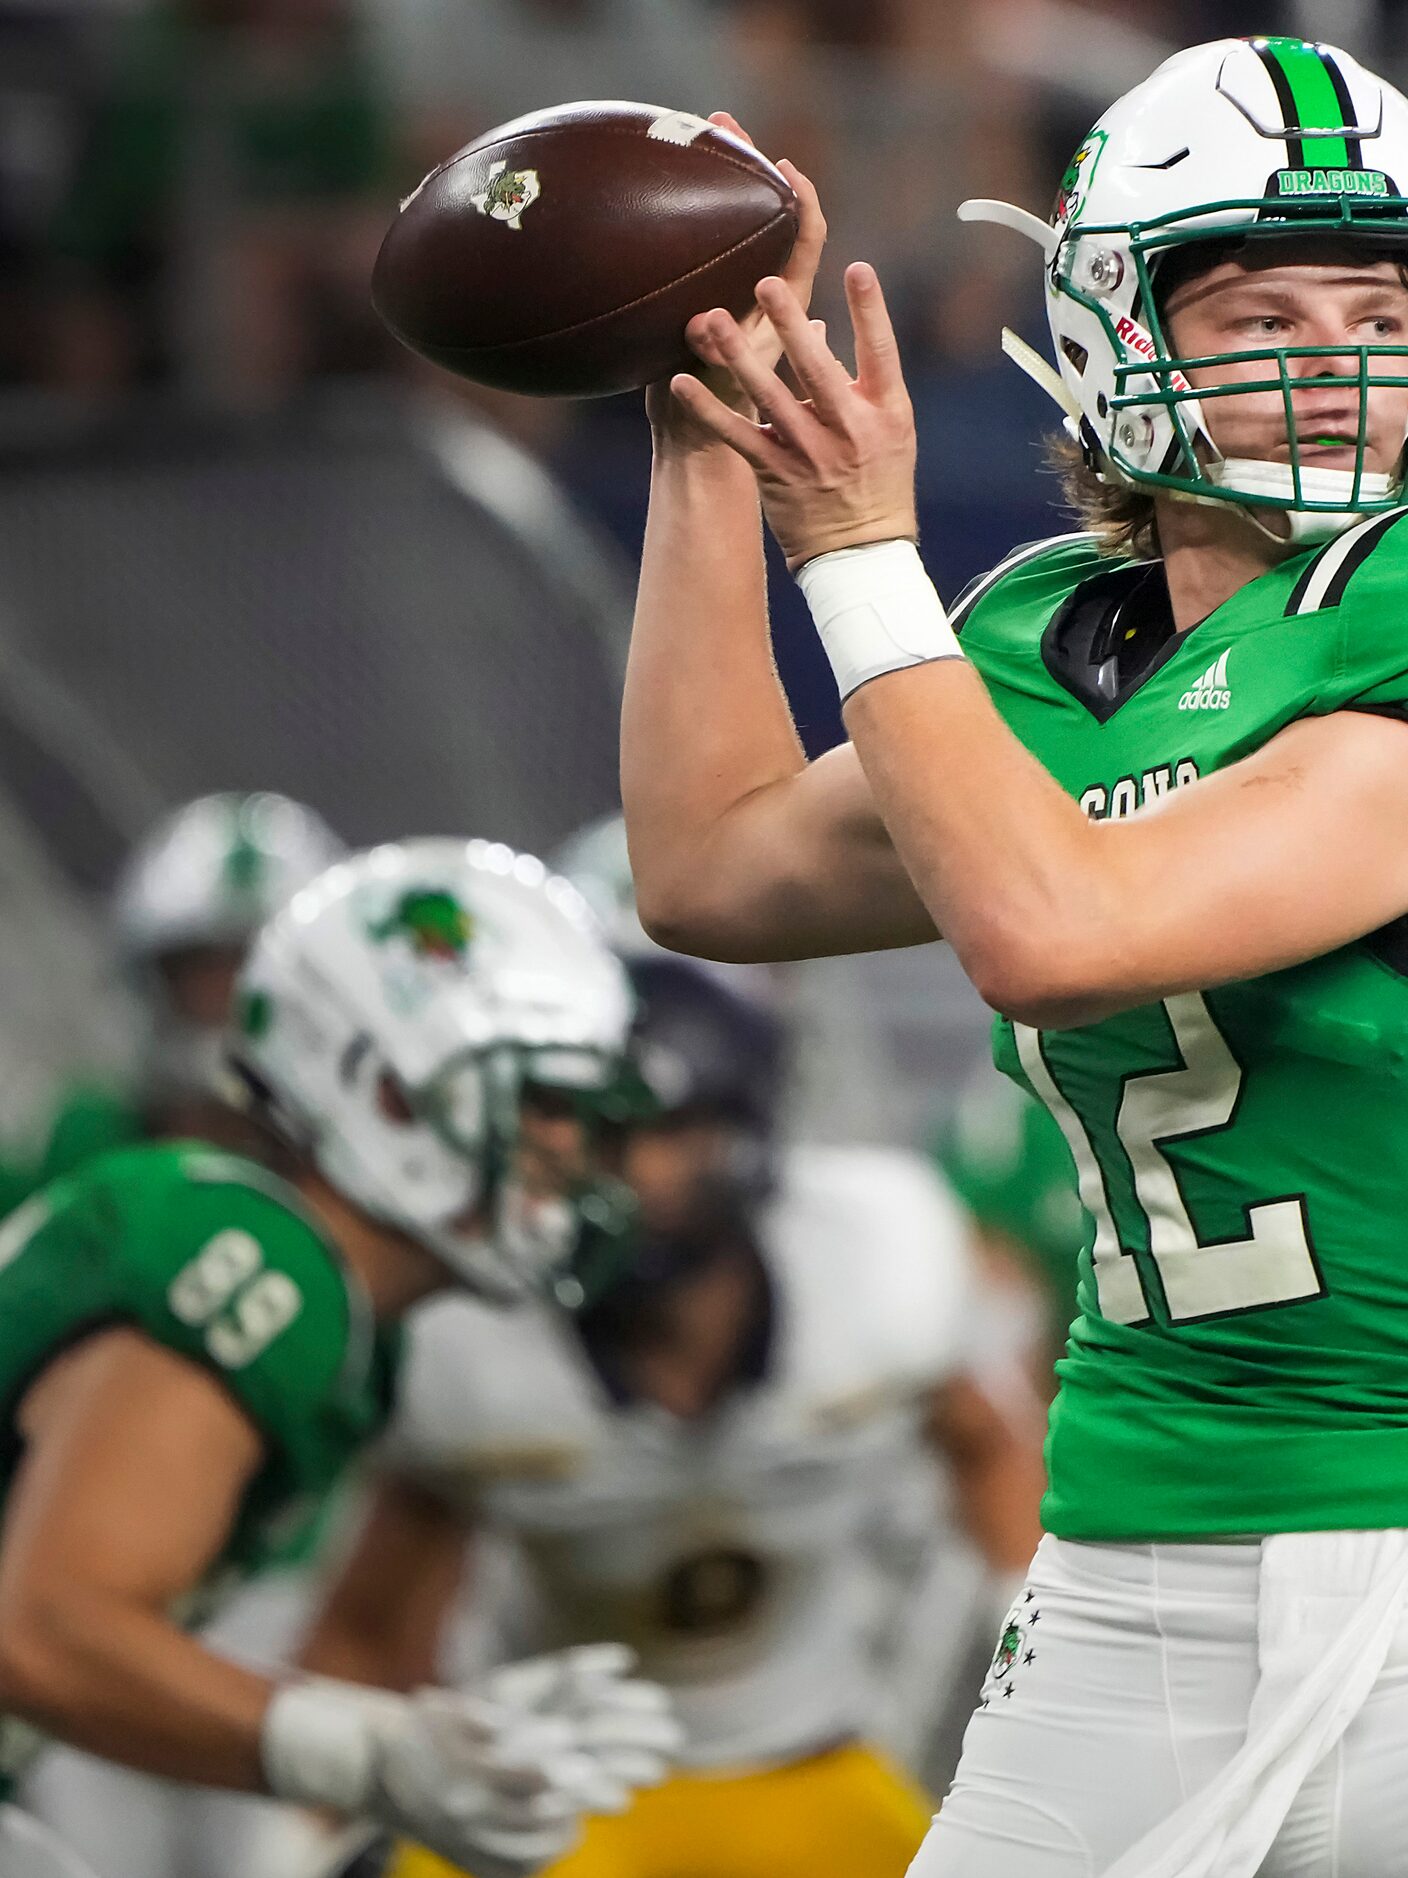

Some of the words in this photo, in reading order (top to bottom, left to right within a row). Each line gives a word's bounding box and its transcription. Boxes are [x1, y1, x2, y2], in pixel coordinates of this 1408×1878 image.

[1277, 170, 1388, 196] DRAGONS
[1178, 685, 1231, 710] adidas
[1009, 990, 1330, 1328] 12
